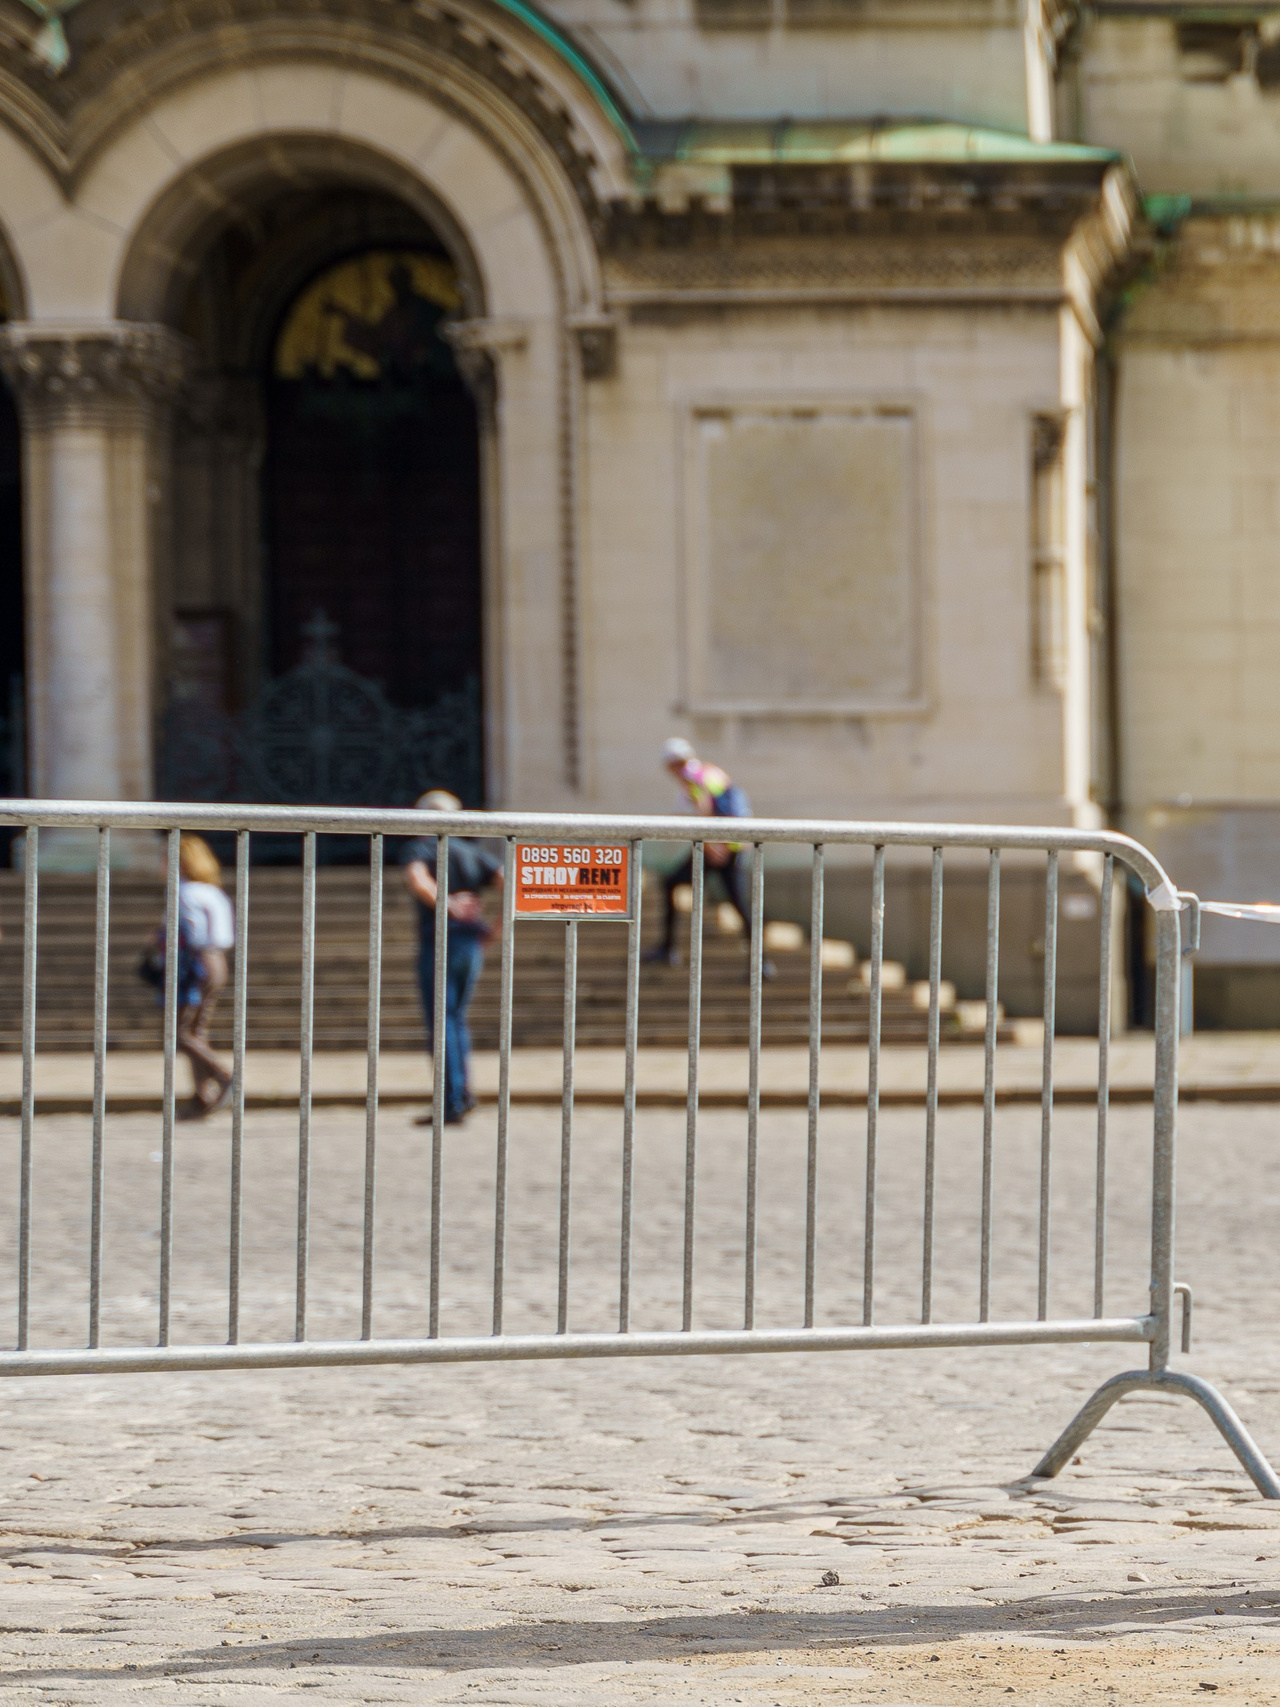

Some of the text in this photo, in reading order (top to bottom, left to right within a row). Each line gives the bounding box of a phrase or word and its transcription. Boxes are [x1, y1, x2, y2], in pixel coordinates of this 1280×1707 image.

[521, 847, 622, 864] 0895 560 320
[521, 866, 621, 885] STROYRENT
